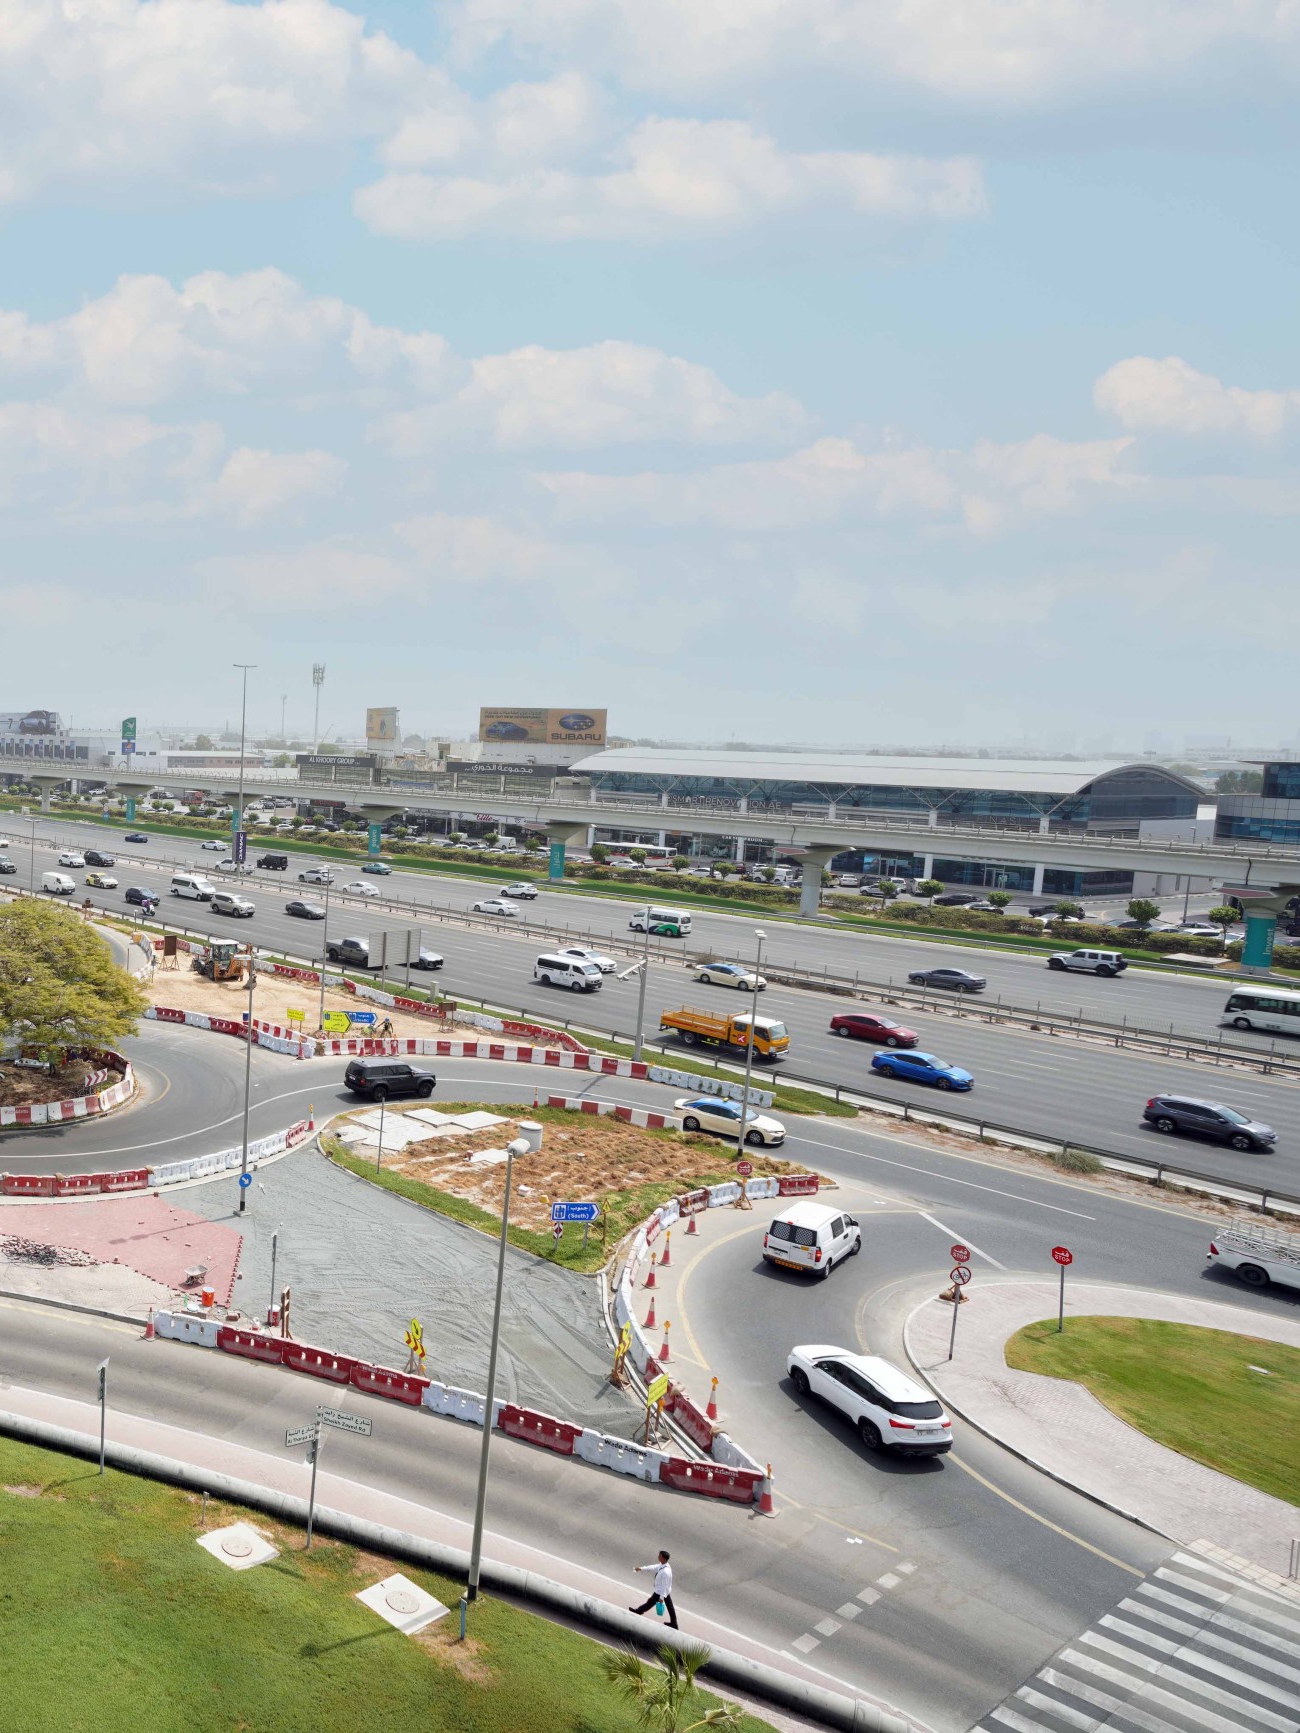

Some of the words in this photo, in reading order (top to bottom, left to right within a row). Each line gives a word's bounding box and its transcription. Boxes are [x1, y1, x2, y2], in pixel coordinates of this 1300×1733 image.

[551, 733, 602, 741] SUBARU
[498, 764, 533, 774] مجموعة
[1262, 928, 1274, 955] Invest
[953, 1252, 968, 1260] STOP
[1054, 1254, 1070, 1262] STOP
[324, 1417, 341, 1425] Sheikh
[342, 1422, 357, 1430] Zayed
[604, 1439, 623, 1449] Wade
[624, 1445, 648, 1457] Adams
[693, 1465, 713, 1473] Wade
[714, 1468, 739, 1478] Adams
